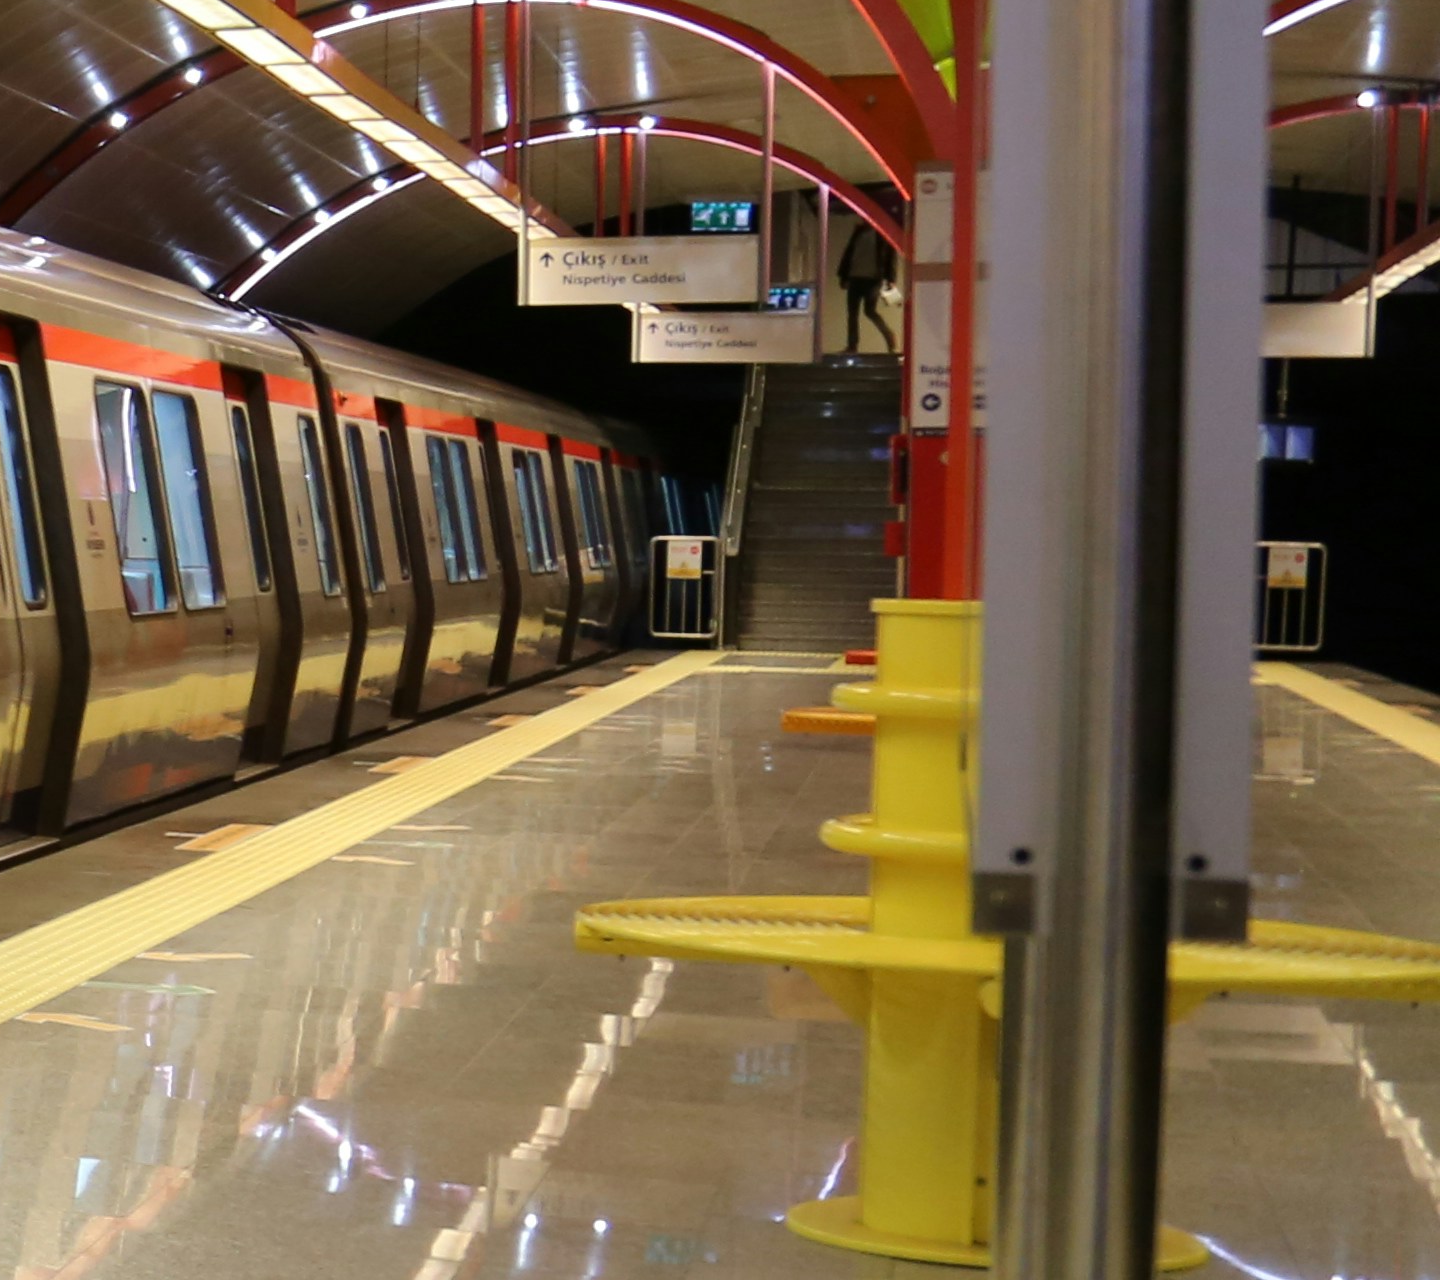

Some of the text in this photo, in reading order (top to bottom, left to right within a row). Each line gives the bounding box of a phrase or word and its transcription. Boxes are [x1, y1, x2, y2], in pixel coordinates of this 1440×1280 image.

[562, 252, 606, 269] Çıkış
[621, 255, 649, 265] Exit
[562, 272, 686, 286] Nispetiye Caddesi
[665, 322, 698, 335] Çıkış
